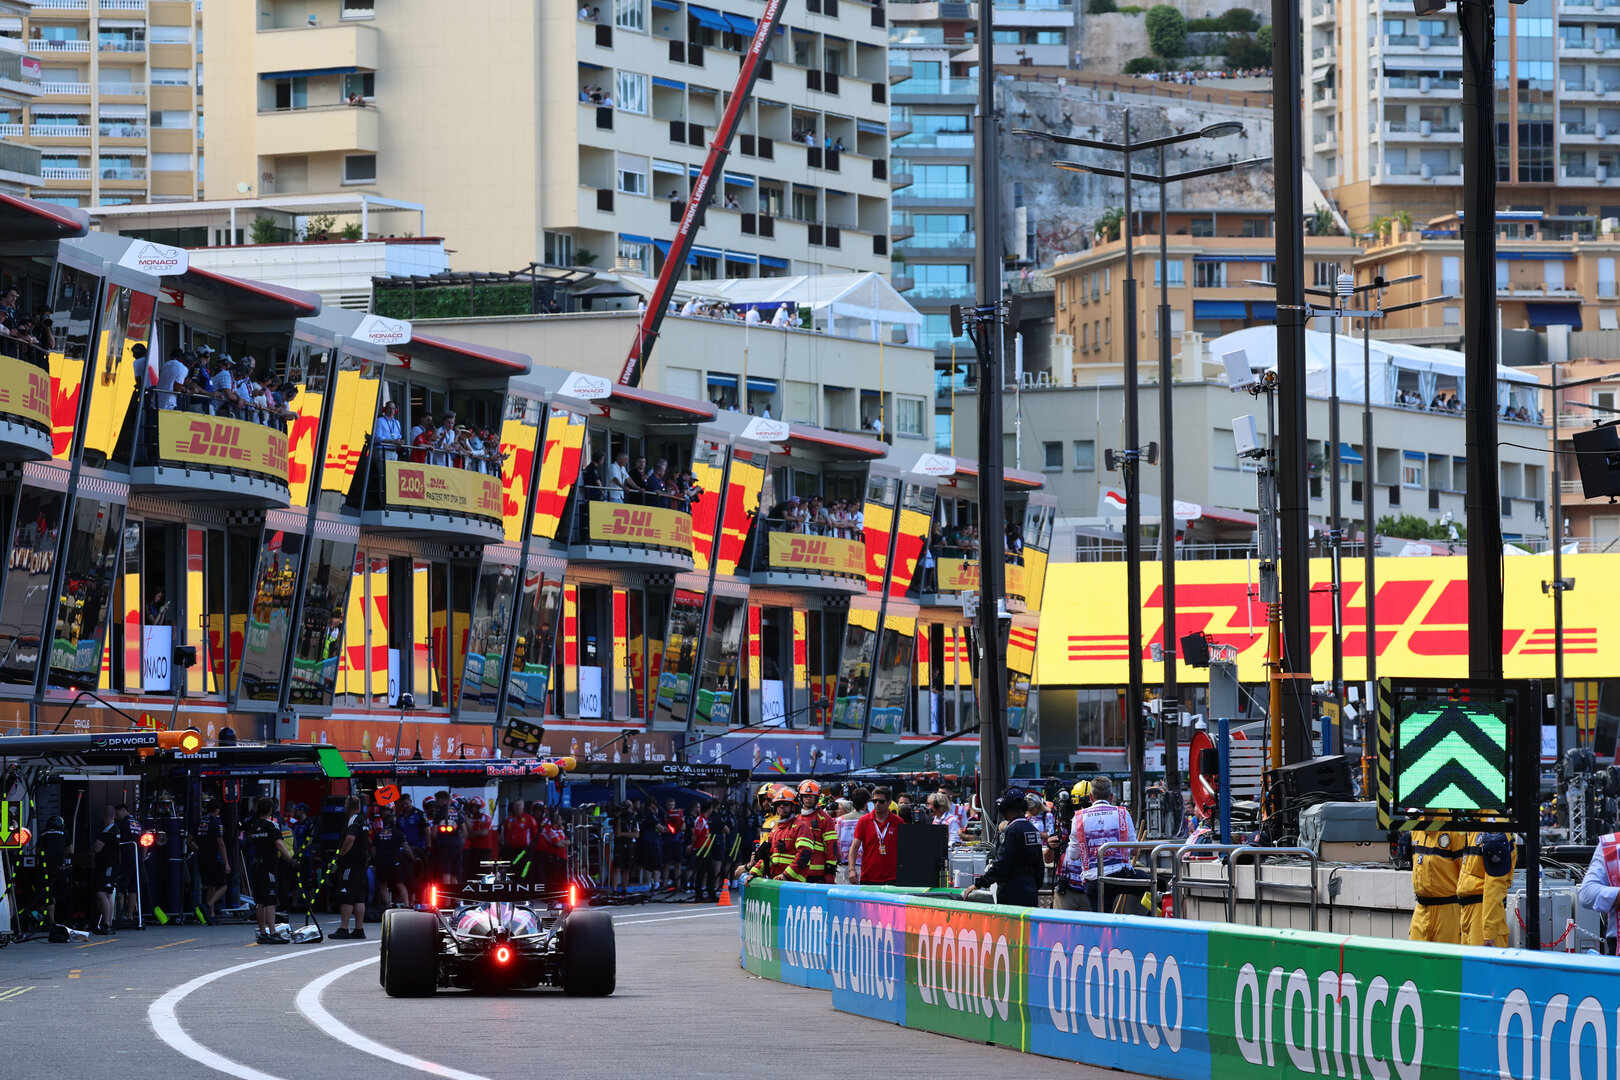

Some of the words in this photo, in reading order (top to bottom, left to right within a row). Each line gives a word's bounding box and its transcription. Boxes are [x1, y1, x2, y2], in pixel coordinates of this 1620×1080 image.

[680, 202, 699, 235] IMPERIAL
[694, 174, 709, 202] LEVAGE
[620, 357, 637, 384] LEVAGE
[189, 421, 244, 460] DHL
[400, 476, 424, 493] 2.00s
[429, 477, 447, 490] DHL
[613, 508, 655, 538] DHL
[790, 538, 829, 565] DHL
[1143, 578, 1525, 660] DHL
[144, 655, 167, 679] NACO
[580, 692, 598, 713] NACO
[74, 719, 90, 729] ORACLE
[109, 738, 121, 746] DP
[122, 737, 156, 745] WORLD
[376, 736, 384, 752] 44
[385, 748, 411, 756] HAMTON
[456, 748, 476, 756] LELERC
[174, 751, 217, 759] Einhell
[462, 883, 546, 893] ALPINE
[831, 915, 895, 1001] aramco
[918, 923, 1010, 1022] aramco
[1048, 941, 1183, 1053] aramco
[1234, 961, 1424, 1080] aramco
[1498, 988, 1620, 1080] ara
